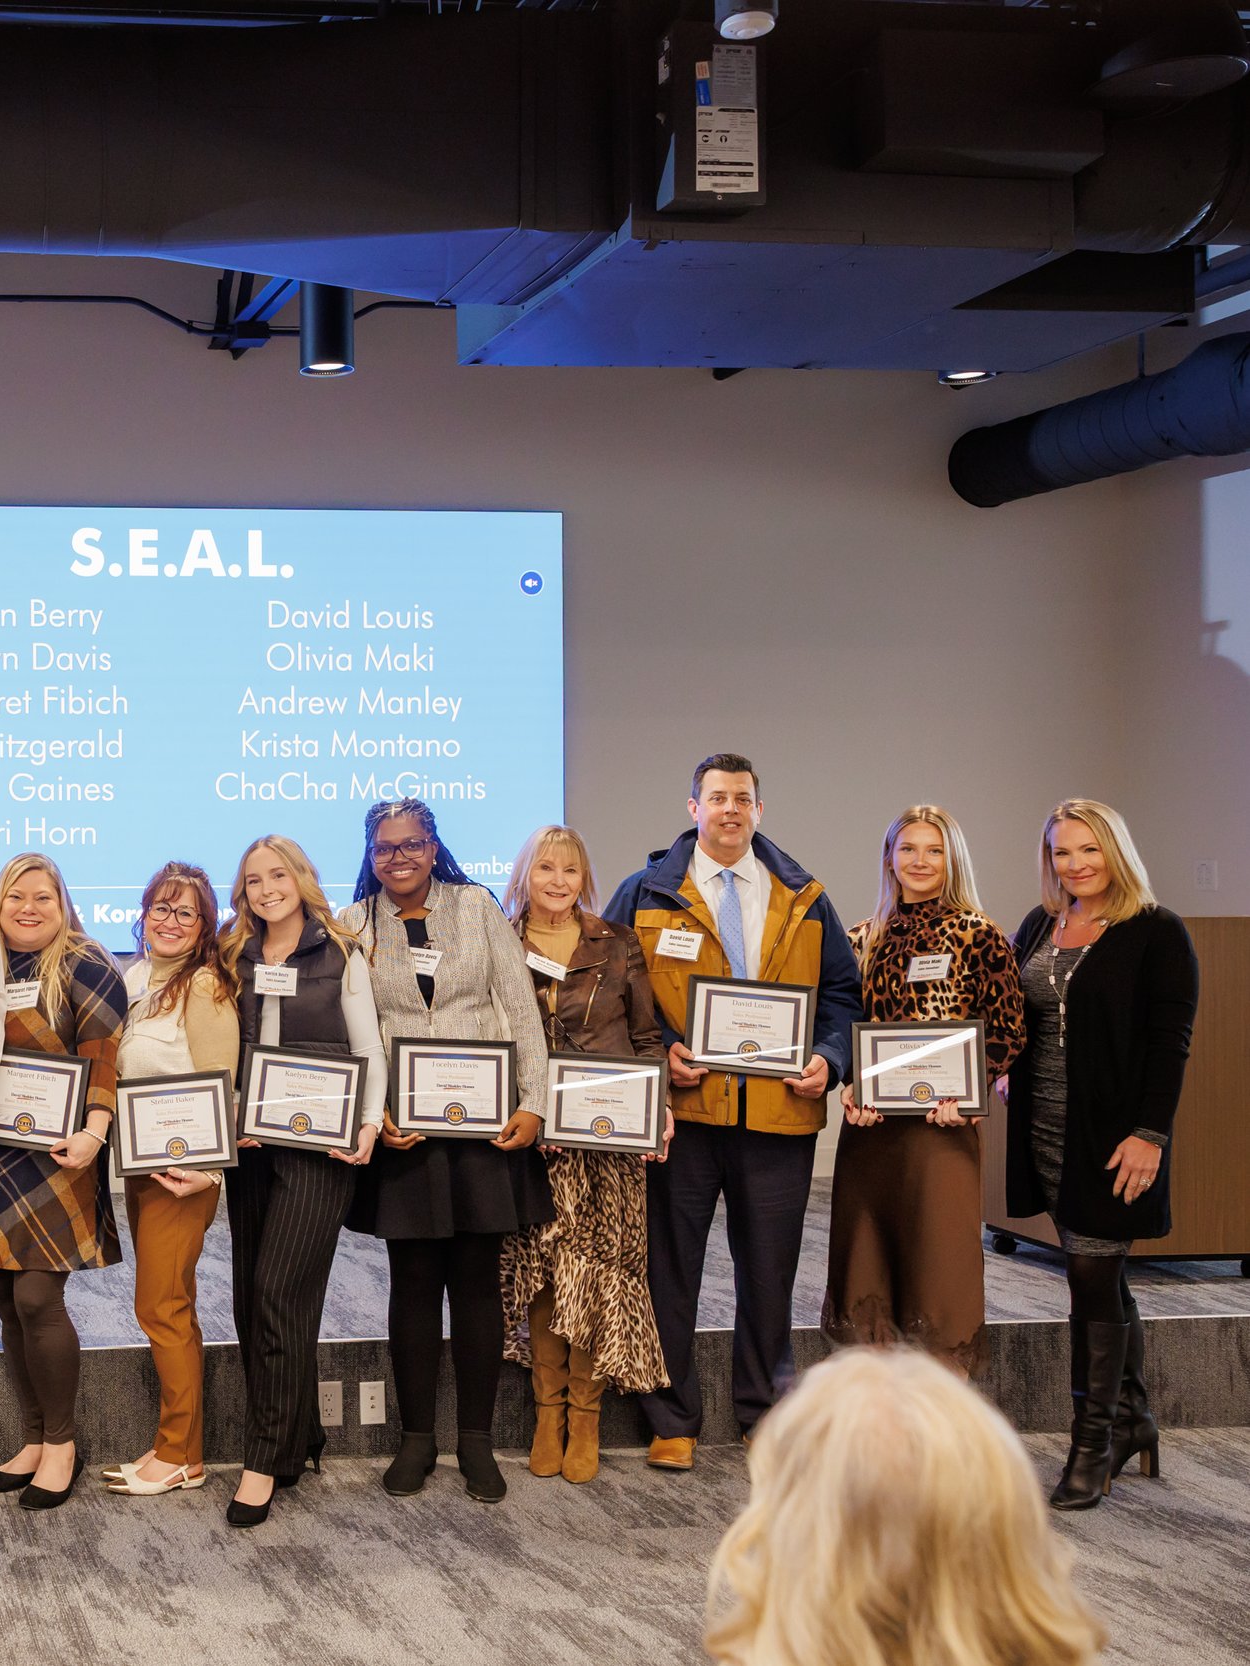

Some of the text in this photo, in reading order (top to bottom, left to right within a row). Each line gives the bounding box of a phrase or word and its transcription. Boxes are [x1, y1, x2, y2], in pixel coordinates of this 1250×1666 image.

[70, 527, 294, 579] S.E.A.L.
[30, 598, 103, 635] Berry
[268, 599, 434, 629] David Louis
[32, 642, 112, 671] Davis
[266, 642, 434, 672] Olivia Maki
[43, 685, 128, 715] Fibich
[238, 685, 462, 722] Andrew Manley
[242, 730, 461, 758] Krista Montano
[8, 772, 115, 802] Gaines
[215, 771, 486, 801] ChaCha McGinnis
[24, 817, 97, 846] Horn
[732, 999, 773, 1010] David Louis
[284, 1070, 328, 1082] Kaelyn Berry
[460, 1061, 479, 1069] Davis
